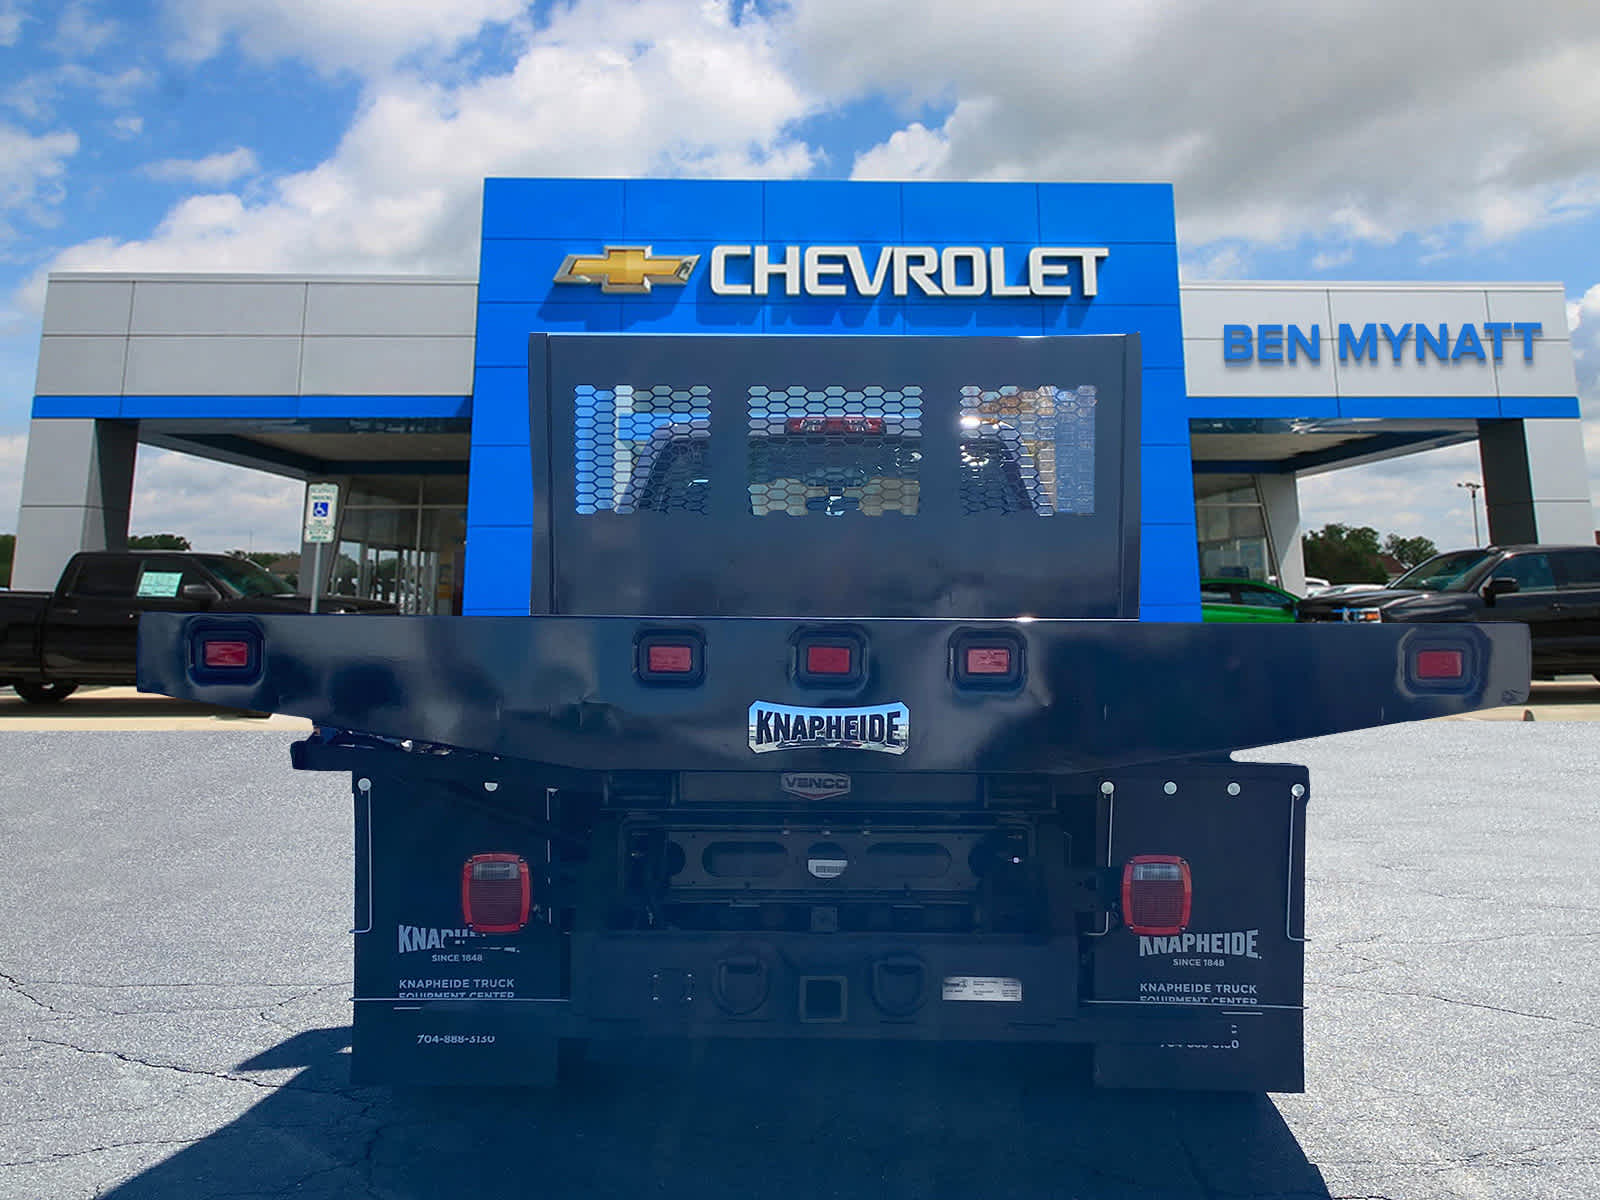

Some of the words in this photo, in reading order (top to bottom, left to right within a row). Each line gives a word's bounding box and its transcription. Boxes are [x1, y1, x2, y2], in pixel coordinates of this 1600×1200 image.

[711, 245, 1110, 297] CHEVROLET
[1223, 324, 1321, 365] BEN
[1338, 322, 1543, 365] MYNATT
[756, 709, 902, 746] KNAPHEIDE
[785, 776, 849, 789] VENCO
[431, 954, 460, 962] SINCE
[462, 954, 483, 962] 1848
[1172, 958, 1201, 967] SINCE
[1203, 958, 1225, 967] 1848
[399, 979, 470, 989] KNAPHEIDE
[473, 978, 515, 988] TRUCK
[1139, 983, 1212, 993] KNAPHEIDE
[1215, 984, 1258, 994] TRUCK
